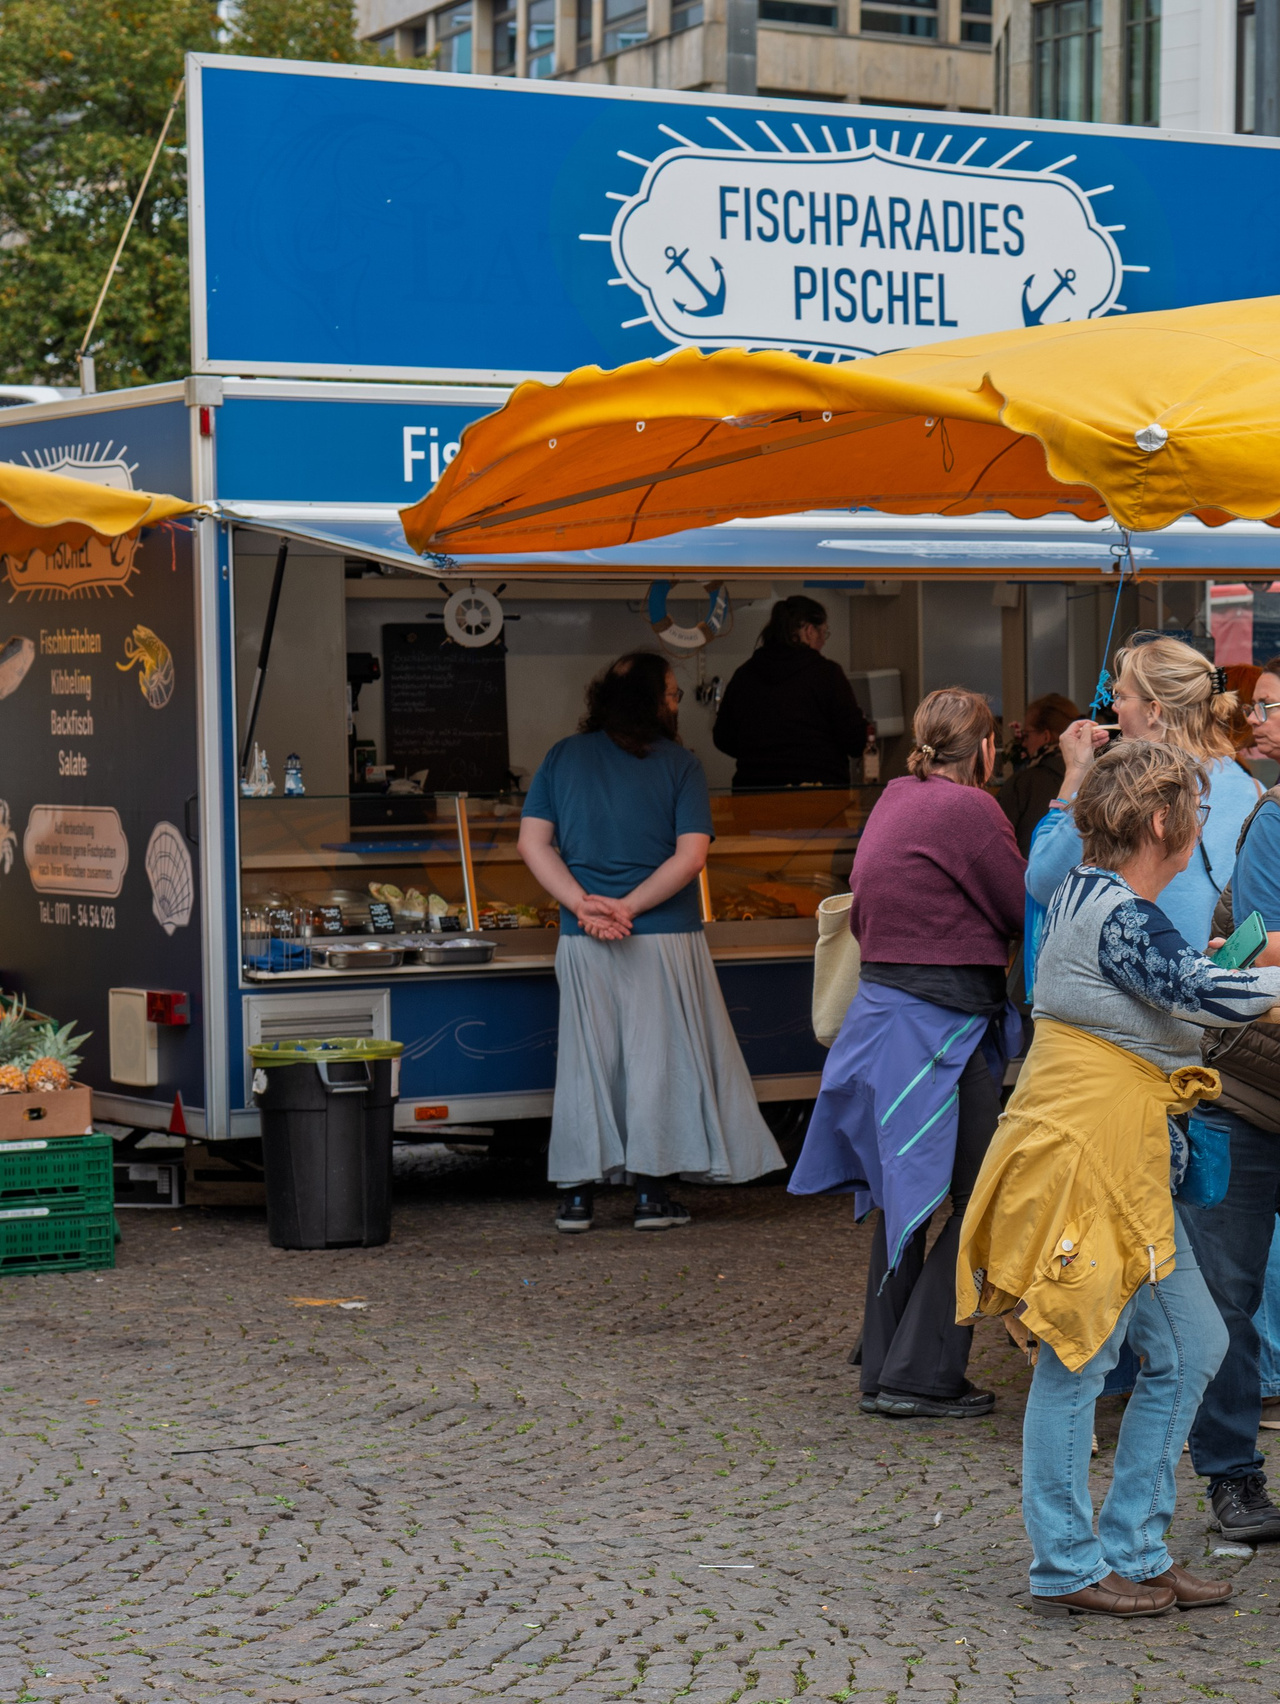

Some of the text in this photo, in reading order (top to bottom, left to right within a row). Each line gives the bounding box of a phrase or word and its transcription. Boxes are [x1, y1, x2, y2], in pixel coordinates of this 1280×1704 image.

[718, 185, 1026, 258] FISCHPARADIES
[793, 264, 959, 329] PISCHEL
[40, 627, 102, 655] Fischbrötchen
[50, 669, 92, 702] Kibbeling
[50, 709, 94, 736] Backfisch
[58, 749, 88, 777] Salate
[54, 902, 71, 925] 0171
[78, 903, 88, 927] 54
[89, 904, 100, 928] 54
[100, 905, 116, 930] 923
